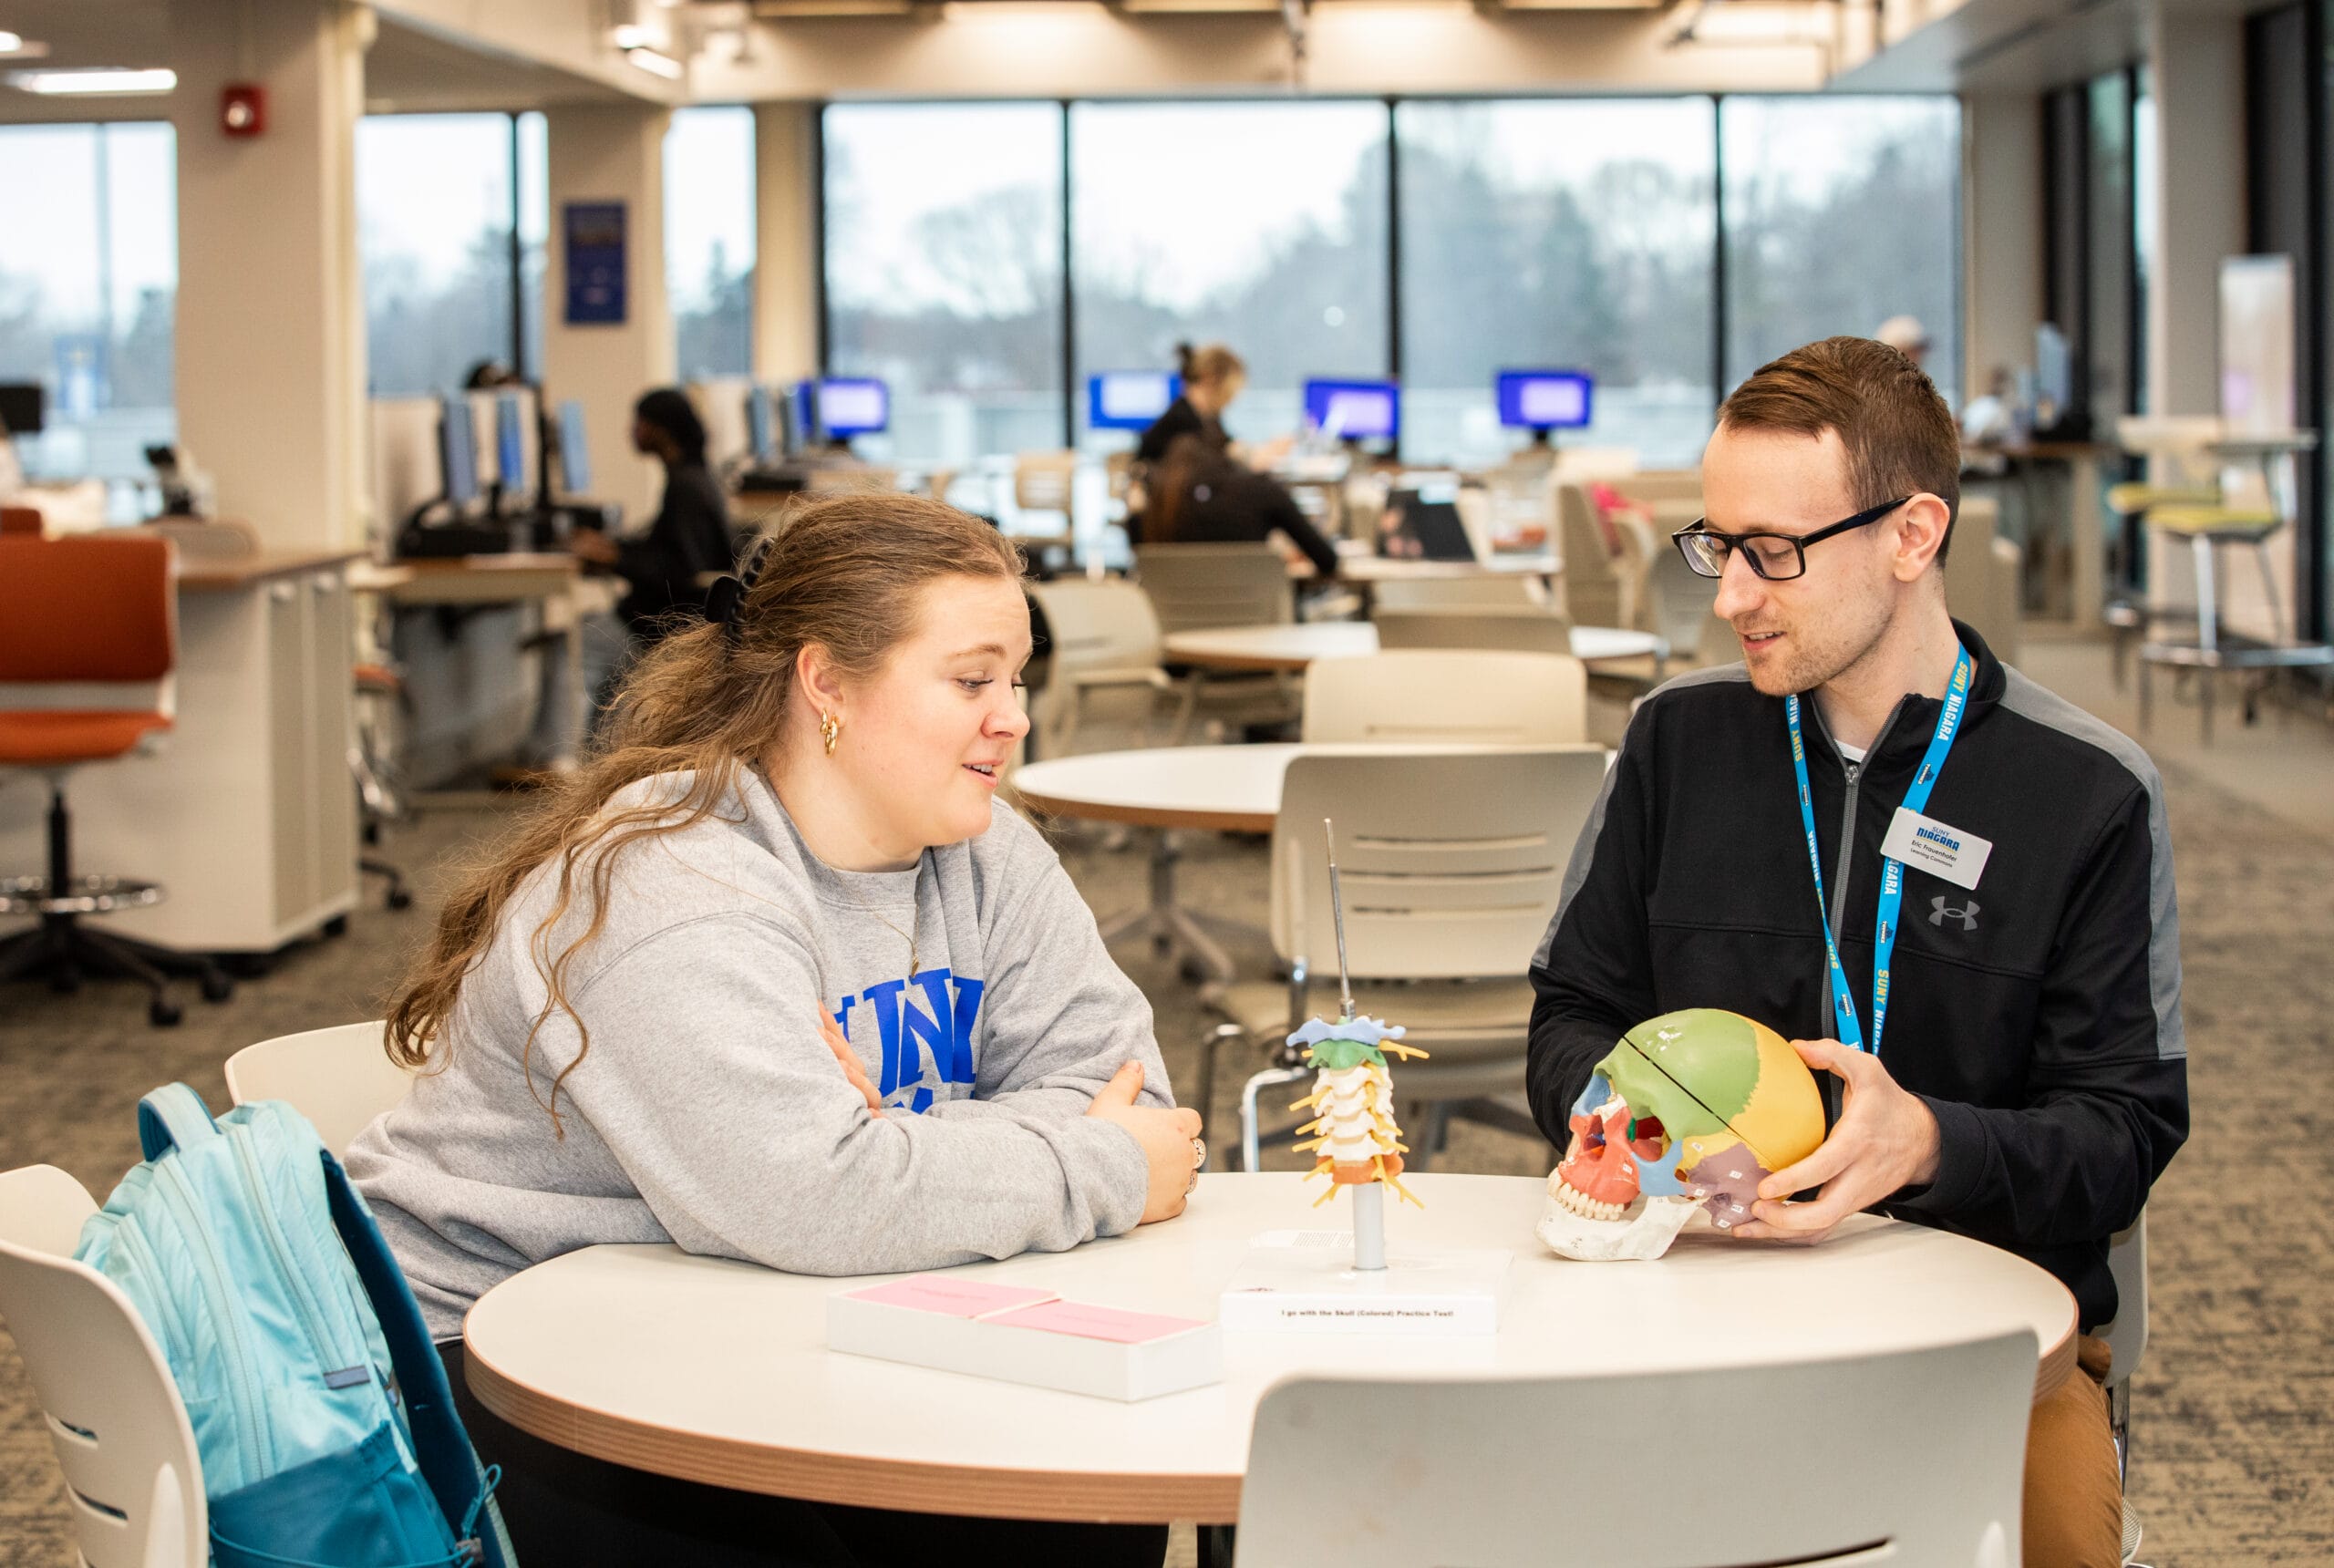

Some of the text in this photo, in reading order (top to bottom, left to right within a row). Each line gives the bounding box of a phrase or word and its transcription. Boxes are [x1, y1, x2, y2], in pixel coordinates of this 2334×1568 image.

[1937, 661, 1968, 741] SUNY NIAGARA
[1789, 694, 1802, 761] SUNY NIAG
[1911, 840, 1922, 848] Eric
[1916, 827, 1960, 851] NIAGARA
[1932, 826, 1950, 837] SUNY
[1885, 859, 1899, 894] AGARA
[1874, 969, 1889, 1055] SUNY NIAGAR
[1357, 1309, 1394, 1318] (Colored)
[1397, 1309, 1430, 1317] Practice
